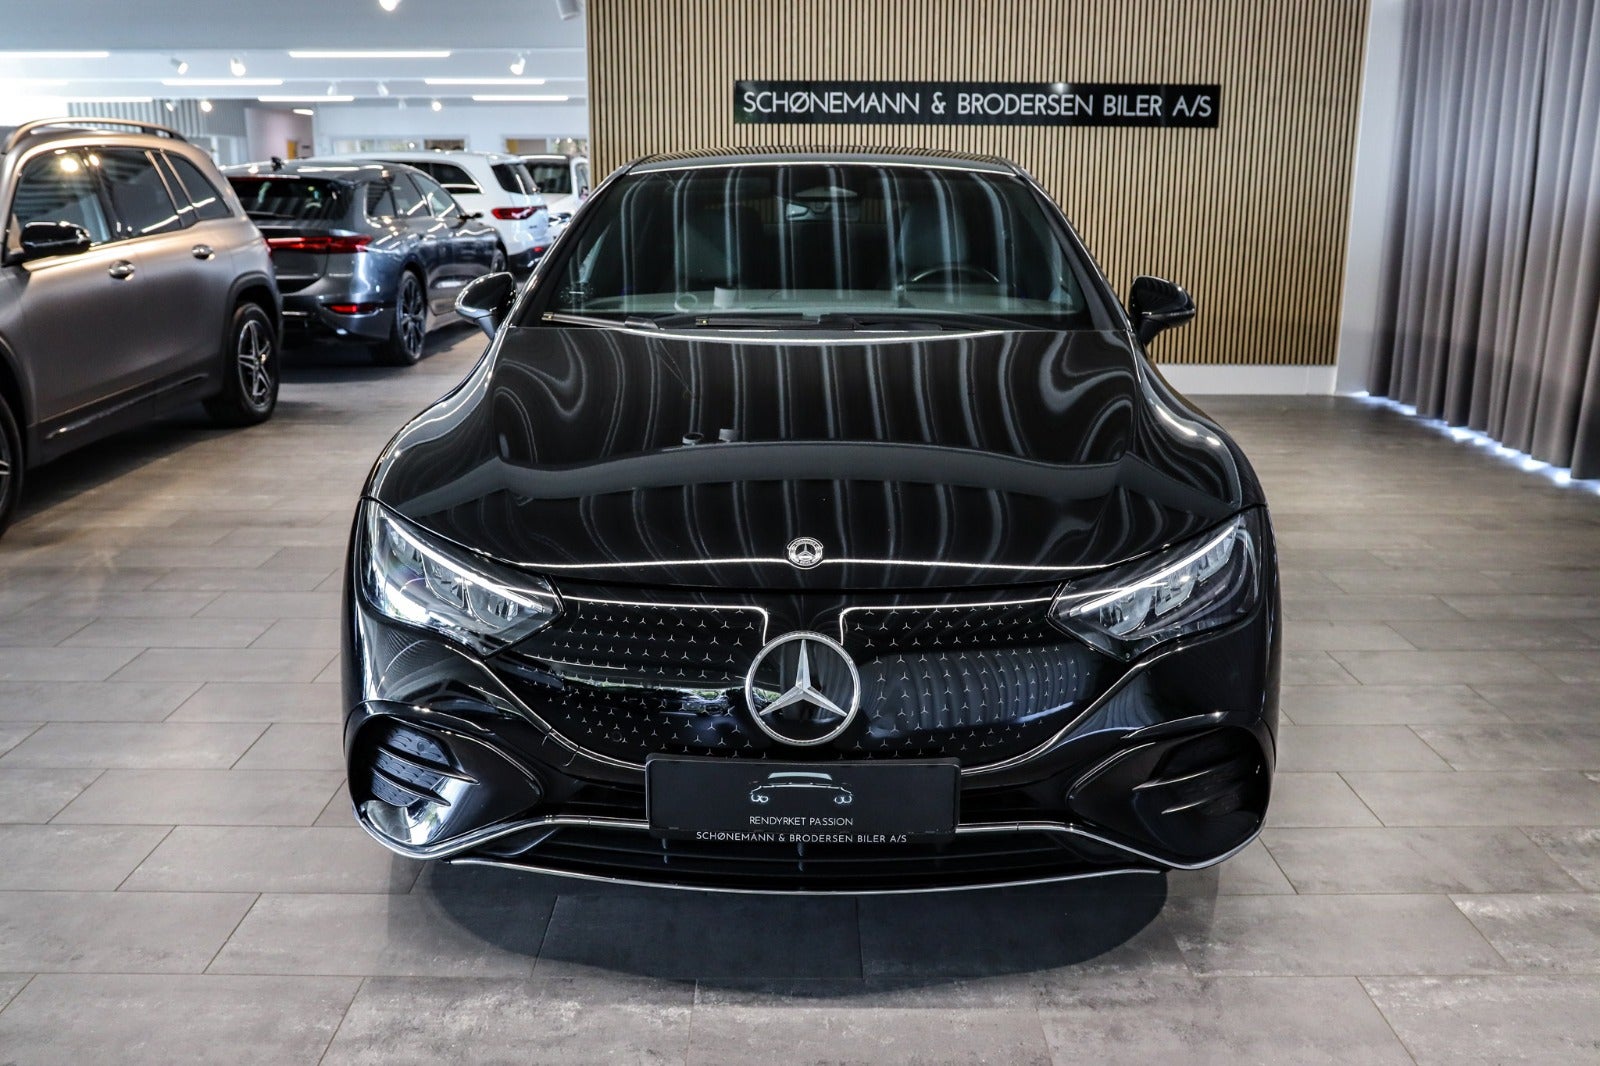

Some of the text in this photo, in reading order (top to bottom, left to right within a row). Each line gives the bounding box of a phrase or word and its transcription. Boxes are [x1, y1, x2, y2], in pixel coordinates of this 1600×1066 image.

[743, 91, 1212, 118] SCHØNEMANN & BRODERSEN BILER A/S
[749, 816, 854, 826] RENDYRKET PASSION
[696, 831, 907, 844] SCHØNEMANN & BRODERSEN BILER A/S
